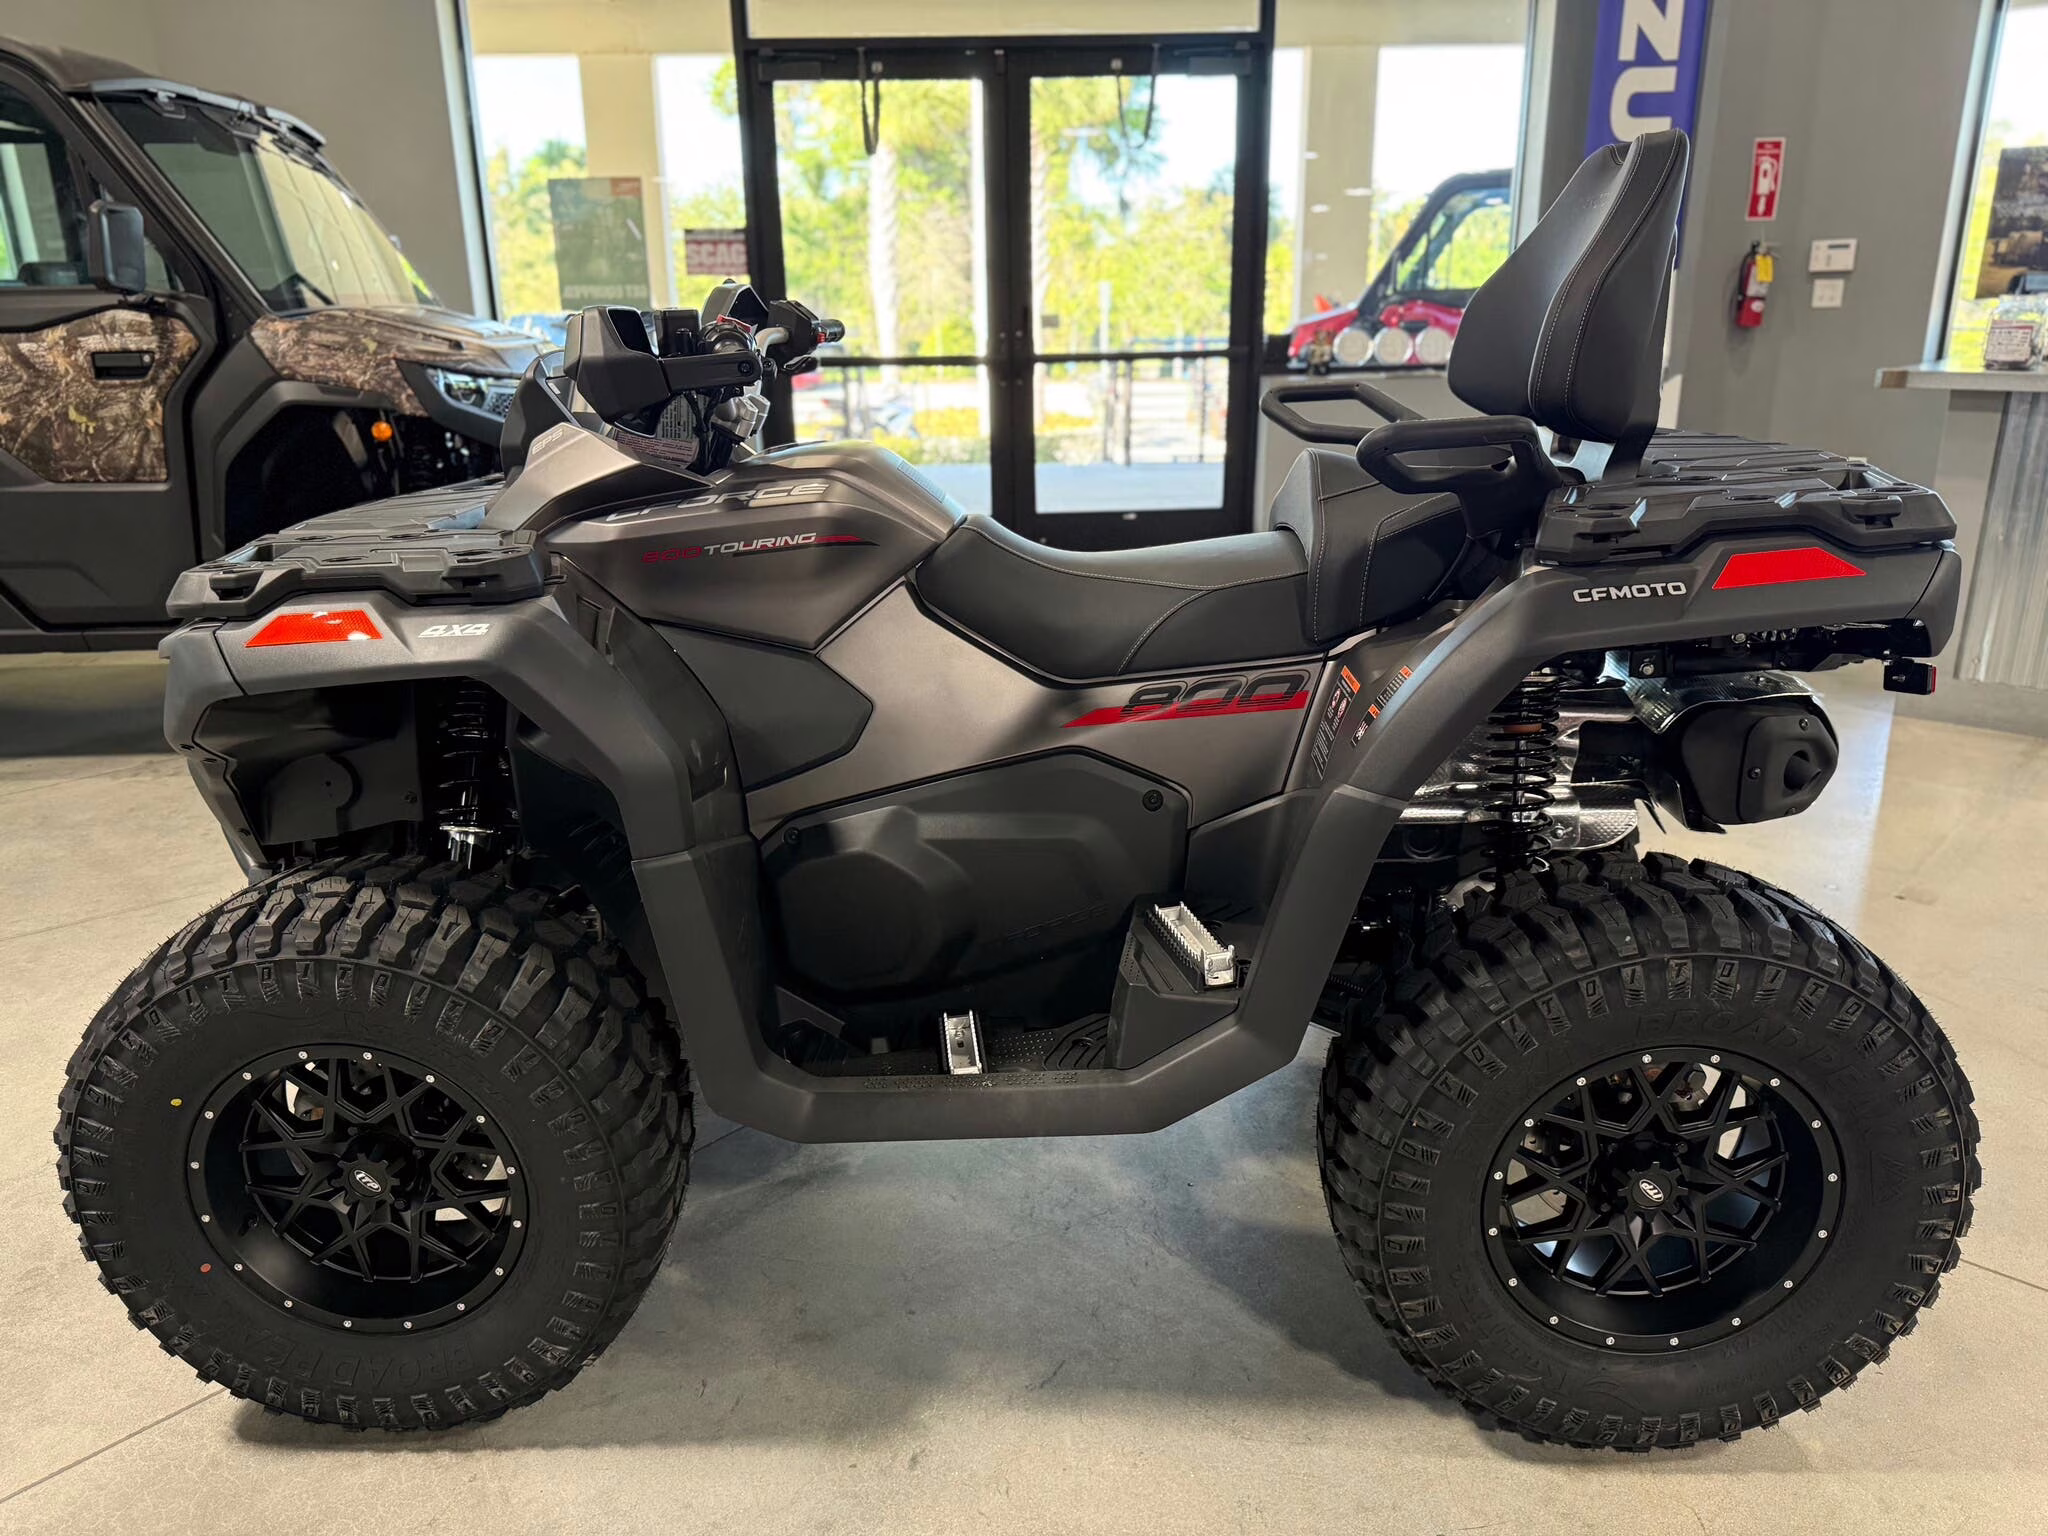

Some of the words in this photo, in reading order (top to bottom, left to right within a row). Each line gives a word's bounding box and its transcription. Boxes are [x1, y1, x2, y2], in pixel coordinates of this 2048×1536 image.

[532, 428, 563, 455] EPS
[606, 483, 829, 522] CFORCE
[641, 545, 703, 564] 800
[704, 532, 817, 556] TOURING
[1572, 581, 1687, 603] CFMOTO
[1120, 670, 1310, 716] 800
[355, 1171, 381, 1190] ITP
[1640, 1182, 1662, 1199] ITP
